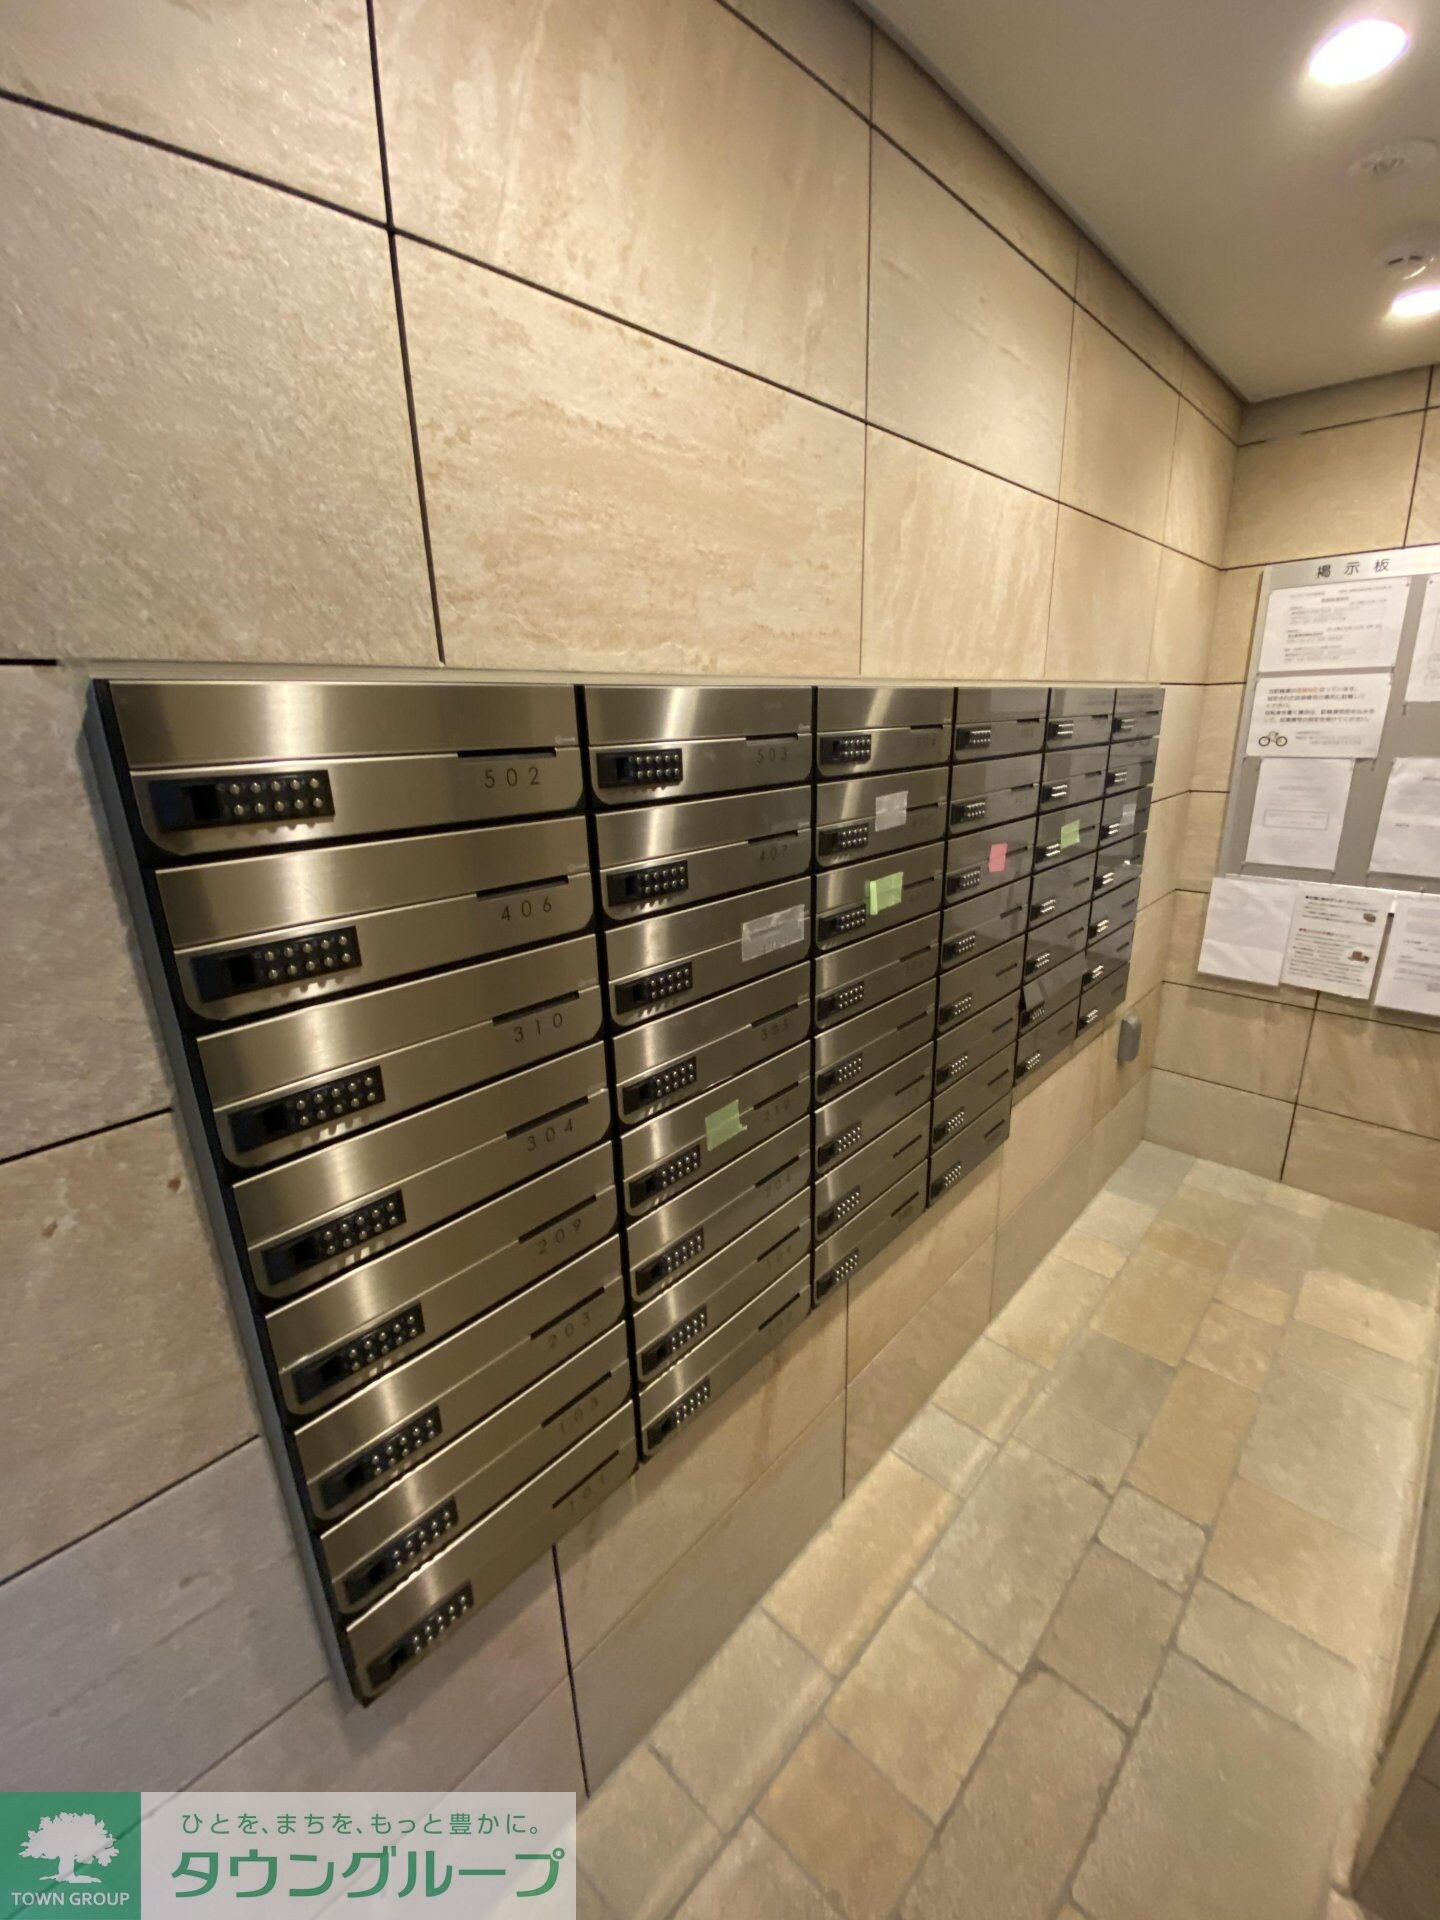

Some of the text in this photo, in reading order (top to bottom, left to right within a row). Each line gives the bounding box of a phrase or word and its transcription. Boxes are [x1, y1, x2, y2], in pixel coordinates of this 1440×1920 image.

[1317, 559, 1390, 578] 掲示板
[756, 746, 789, 763] 503
[484, 767, 540, 789] 502
[501, 898, 552, 922] 406
[514, 1012, 563, 1043] 310
[527, 1122, 574, 1152] 304
[537, 1219, 582, 1255] 209
[547, 1312, 591, 1349] 203
